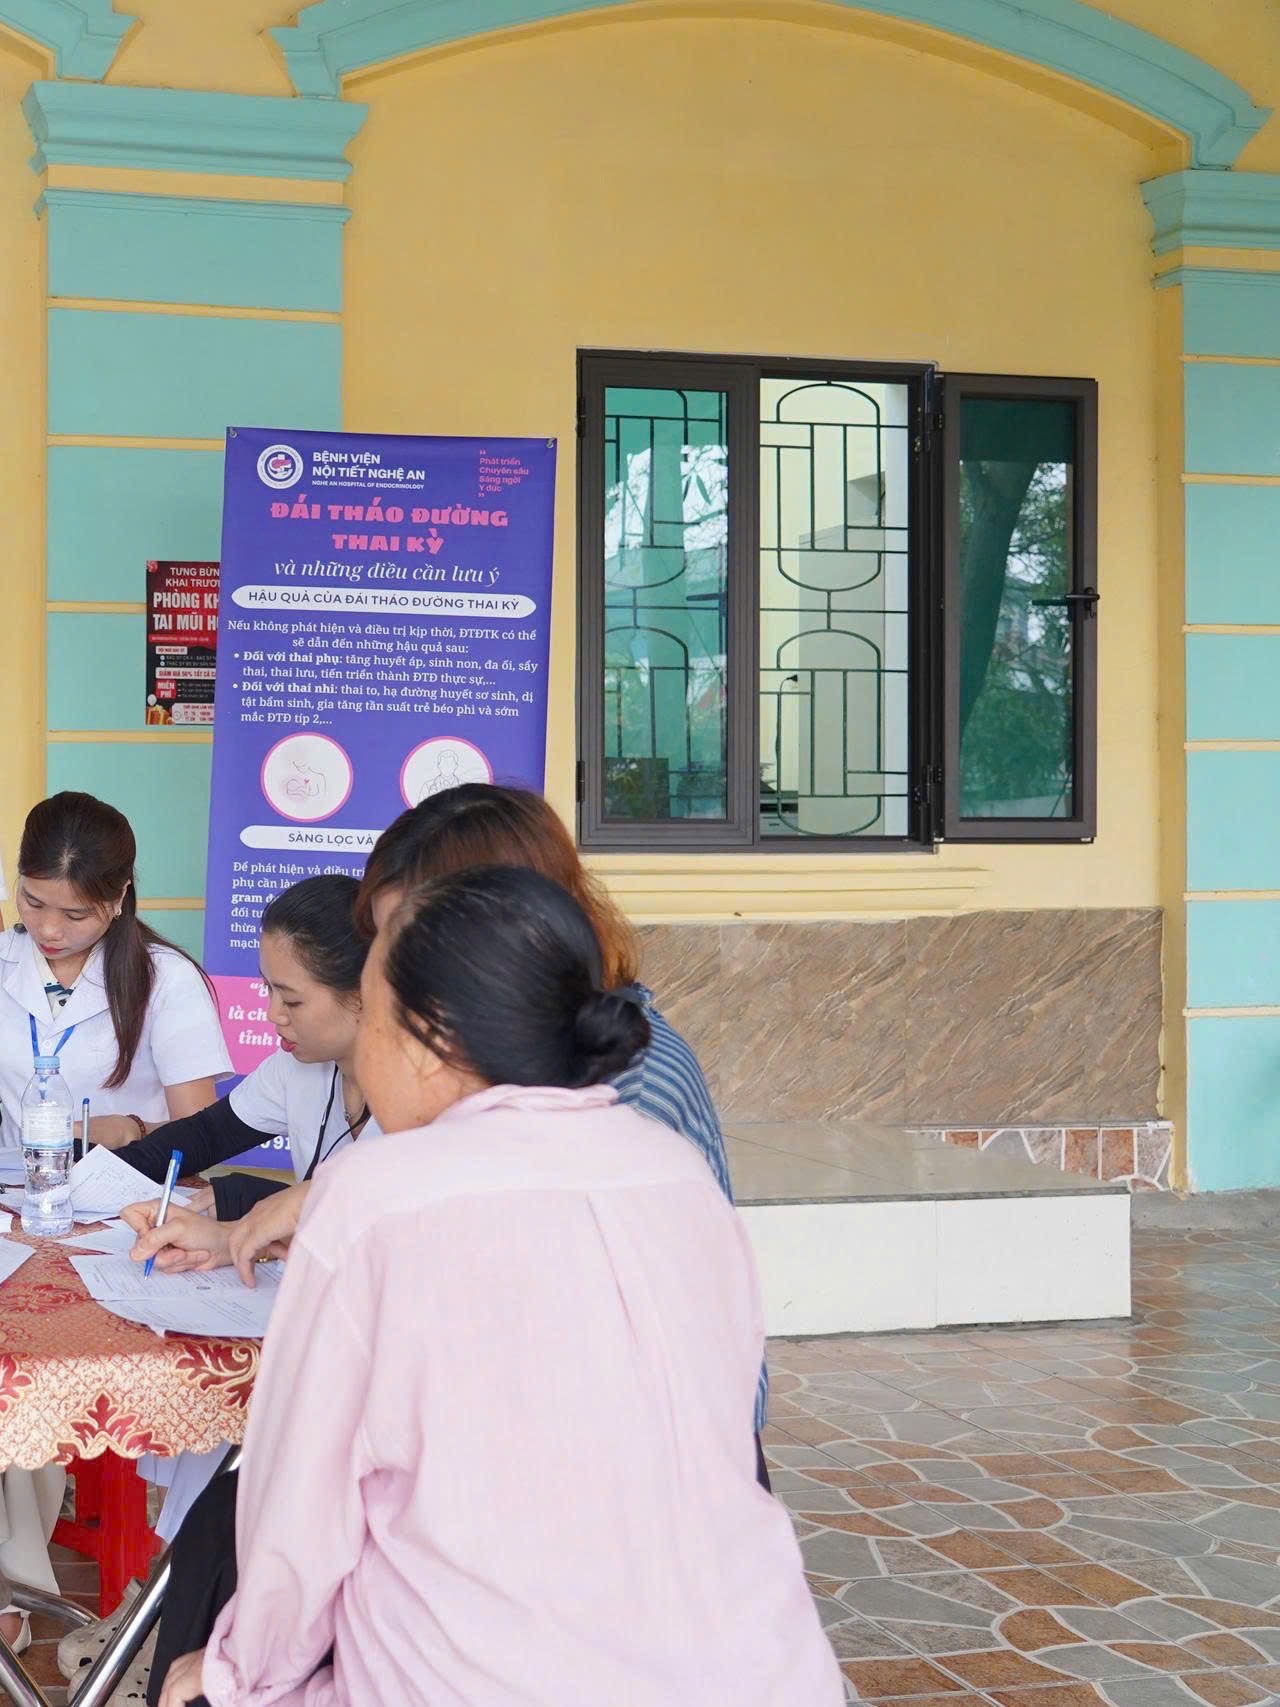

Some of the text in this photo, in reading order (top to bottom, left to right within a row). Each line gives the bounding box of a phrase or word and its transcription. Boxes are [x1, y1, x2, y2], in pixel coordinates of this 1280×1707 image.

[313, 451, 381, 465] BỆNH VIỆN
[313, 465, 425, 482] NỘI TIẾT NGHỆ AN
[480, 467, 512, 475] Chuyên
[271, 494, 508, 527] ĐÁI THÁO ĐƯỜNG
[332, 528, 444, 555] THAI KỲ
[200, 566, 220, 577] BỪN
[275, 560, 296, 576] và
[302, 561, 363, 582] những
[413, 563, 446, 581] cần
[452, 566, 483, 583] lưu
[485, 567, 500, 588] ý
[166, 579, 189, 587] KHAI
[153, 589, 200, 609] PHÒNG
[249, 590, 277, 604] HẬU
[281, 590, 310, 604] QUẢ
[314, 591, 342, 604] CỦA
[372, 594, 409, 606] THÁO
[413, 595, 464, 609] ĐƯỜNG
[468, 600, 498, 609] THAI
[502, 598, 520, 610] KỲ
[153, 612, 219, 631] TAI MŨI H
[228, 620, 537, 641] Nếu không phát hiện và điều trị kịp thời, ĐTĐTK có thể
[293, 637, 469, 654] sẽ dẫn đến những hậu quả sau:
[243, 651, 516, 672] Đối với thai phụ: tăng huyết áp, sinh non, đa ối,
[243, 666, 268, 678] thai,
[271, 667, 293, 678] thai
[296, 668, 318, 680] lưu,
[321, 668, 343, 679] tiến
[346, 669, 374, 681] triển
[377, 670, 410, 682] thành
[413, 672, 438, 682] ĐTĐ
[441, 673, 467, 685] thực
[242, 681, 534, 704] Đối với thai nhi: thai to, hạ đường huyết sơ sinh, dị
[241, 697, 257, 709] tật
[287, 698, 315, 710] sinh,
[317, 700, 335, 712] gia
[337, 700, 363, 713] tăng
[387, 702, 411, 713] suất
[414, 702, 431, 713] trẻ
[434, 703, 454, 714] béo
[478, 705, 492, 716] và
[495, 706, 520, 717] sớm
[267, 712, 292, 723] ĐTĐ
[294, 713, 310, 726] típ
[313, 714, 333, 725] 2,...
[288, 831, 374, 847] SÀNG LỌC VÀ
[251, 863, 277, 875] phát
[280, 864, 304, 875] hiện
[307, 865, 321, 875] và
[324, 865, 349, 876] điều
[233, 877, 277, 889] phụ cần
[231, 894, 263, 905] gram
[231, 908, 249, 918] đối
[231, 923, 257, 934] thừa
[230, 939, 260, 950] mạch
[228, 1005, 245, 1020] là
